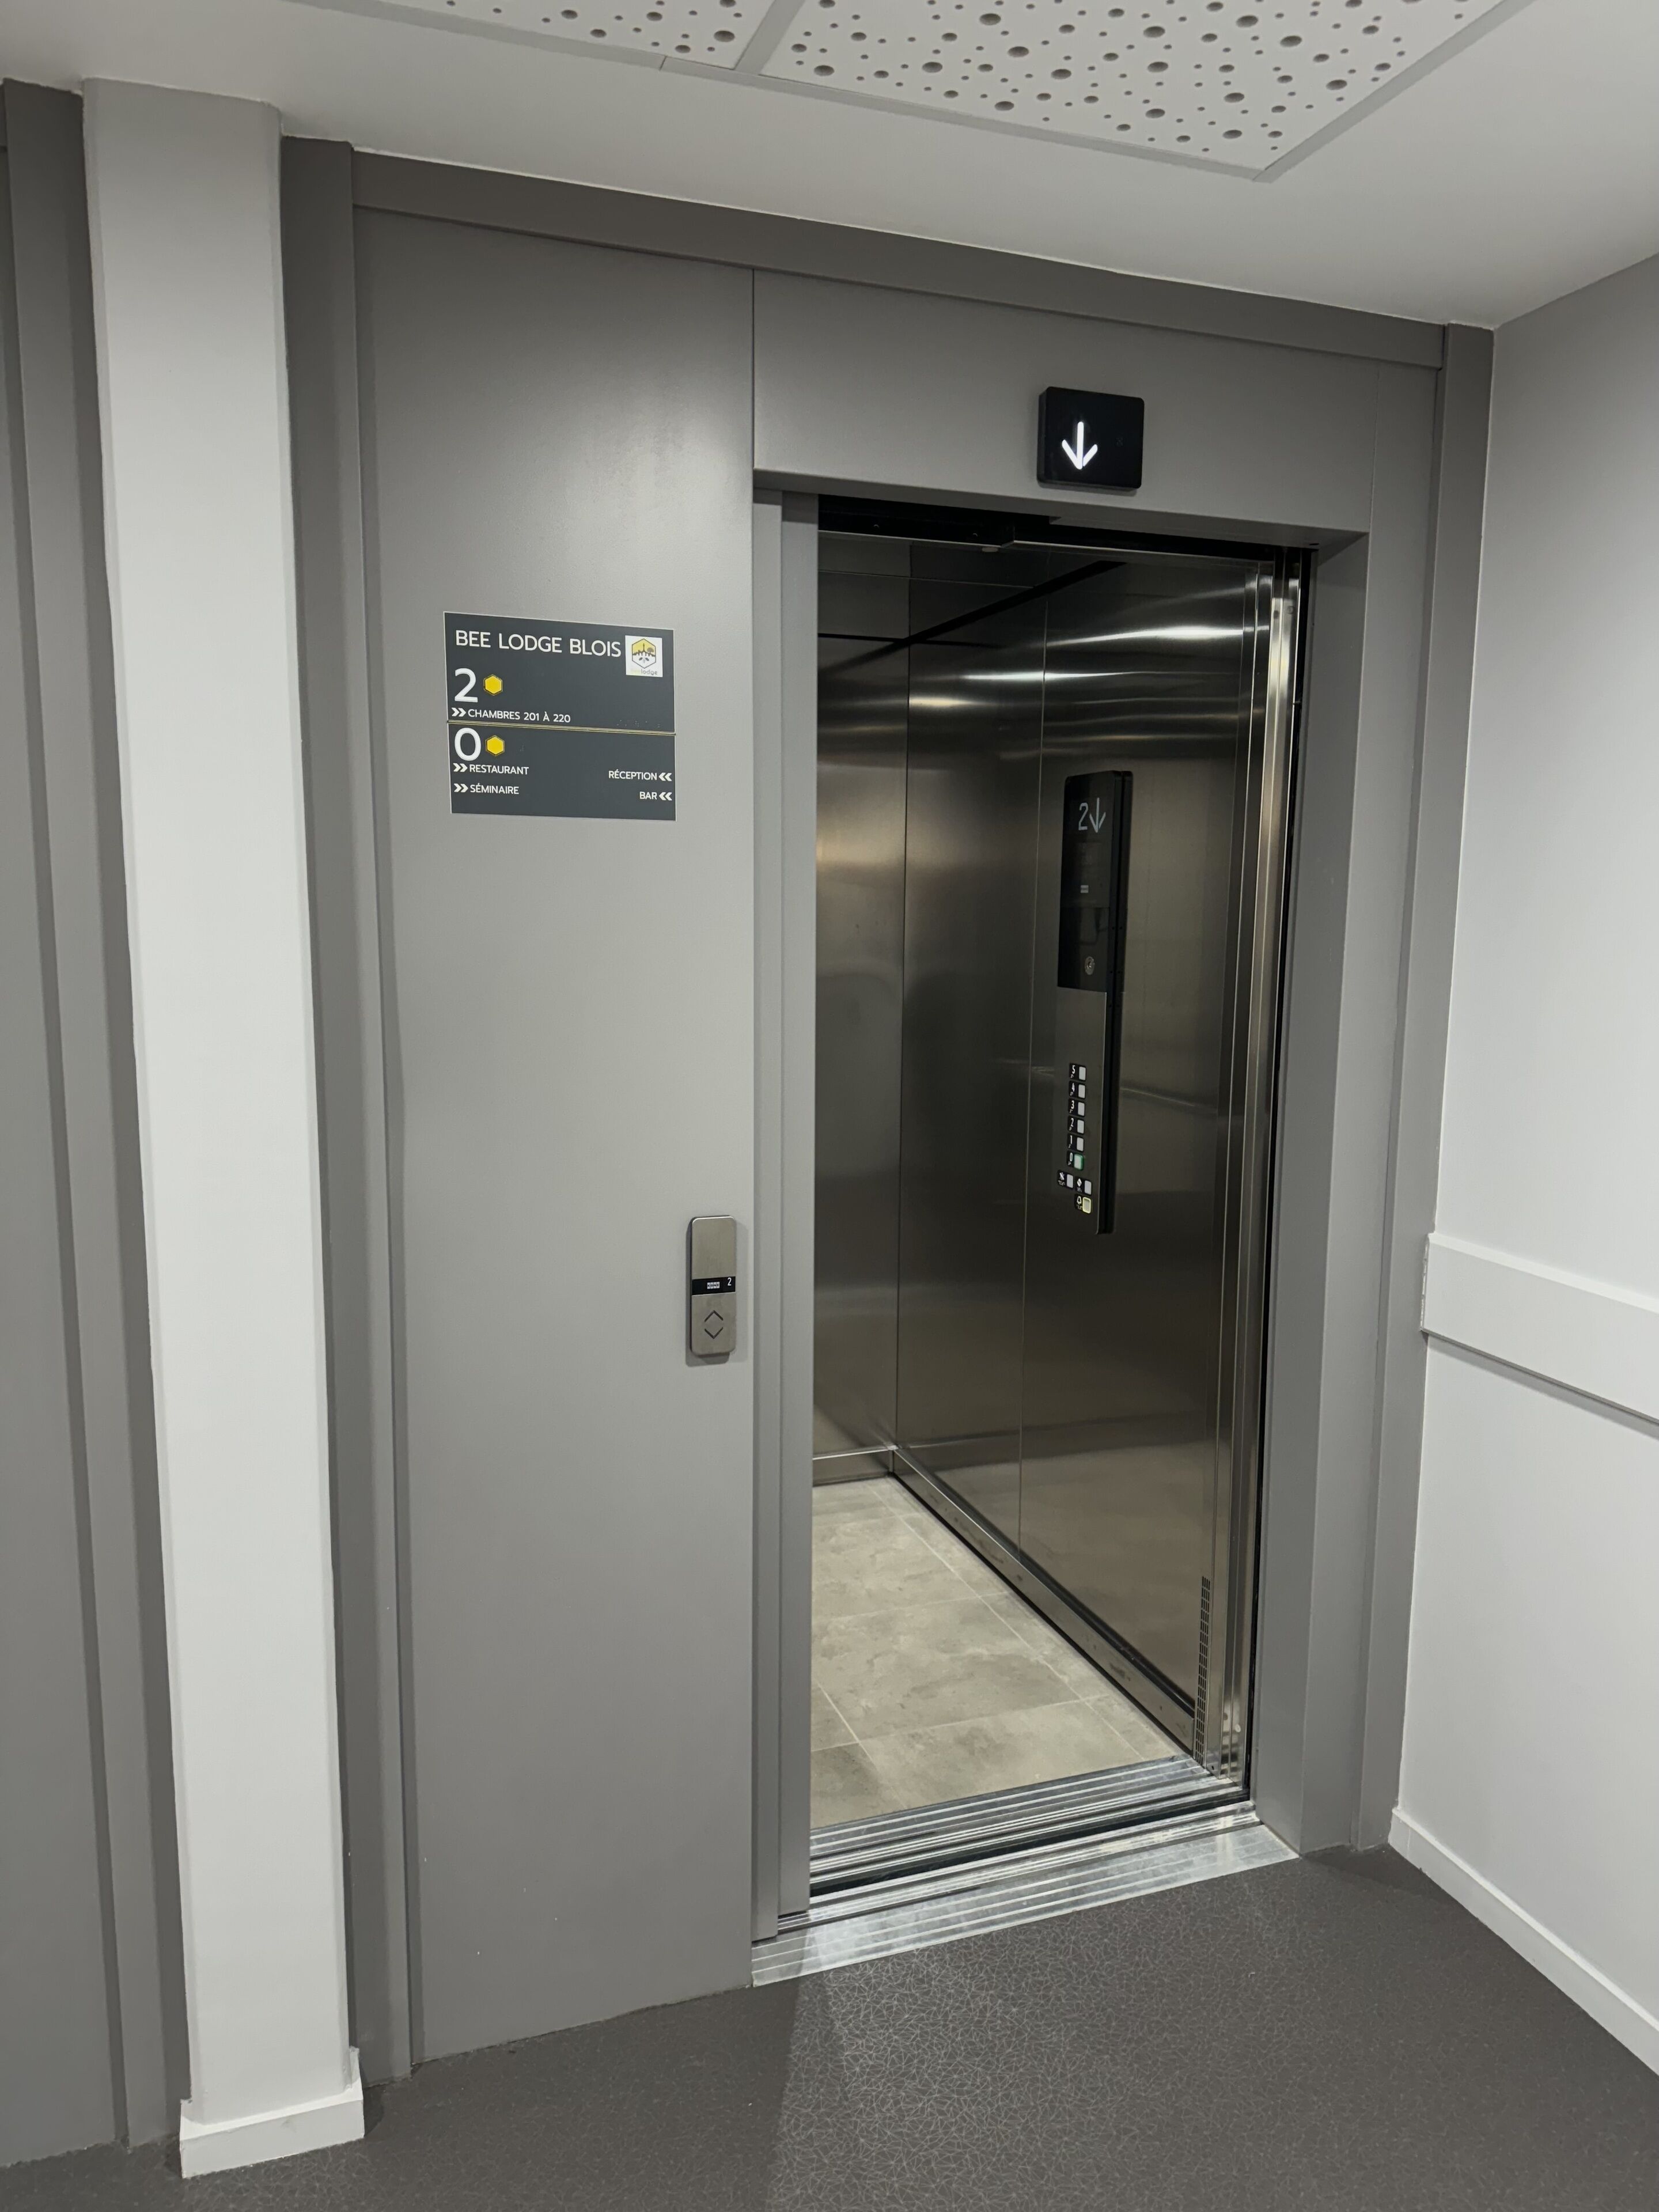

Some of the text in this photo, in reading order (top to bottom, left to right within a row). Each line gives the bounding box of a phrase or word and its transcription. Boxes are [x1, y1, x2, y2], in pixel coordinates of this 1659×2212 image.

[456, 630, 622, 657] BEE LODGE BLOIS
[454, 668, 478, 703] 2
[468, 709, 571, 723] CHAMBRES 201 À 220
[454, 727, 482, 761] 0
[469, 764, 529, 775] RESTAURANT
[608, 769, 657, 781] RÉCEPTION
[469, 783, 520, 794] SÉMINAIRE
[639, 791, 657, 800] BAR
[1078, 802, 1089, 831] 2
[1071, 1065, 1075, 1074] 5
[1071, 1100, 1075, 1109] 3
[1070, 1118, 1074, 1127] 2
[727, 1277, 732, 1286] 2
